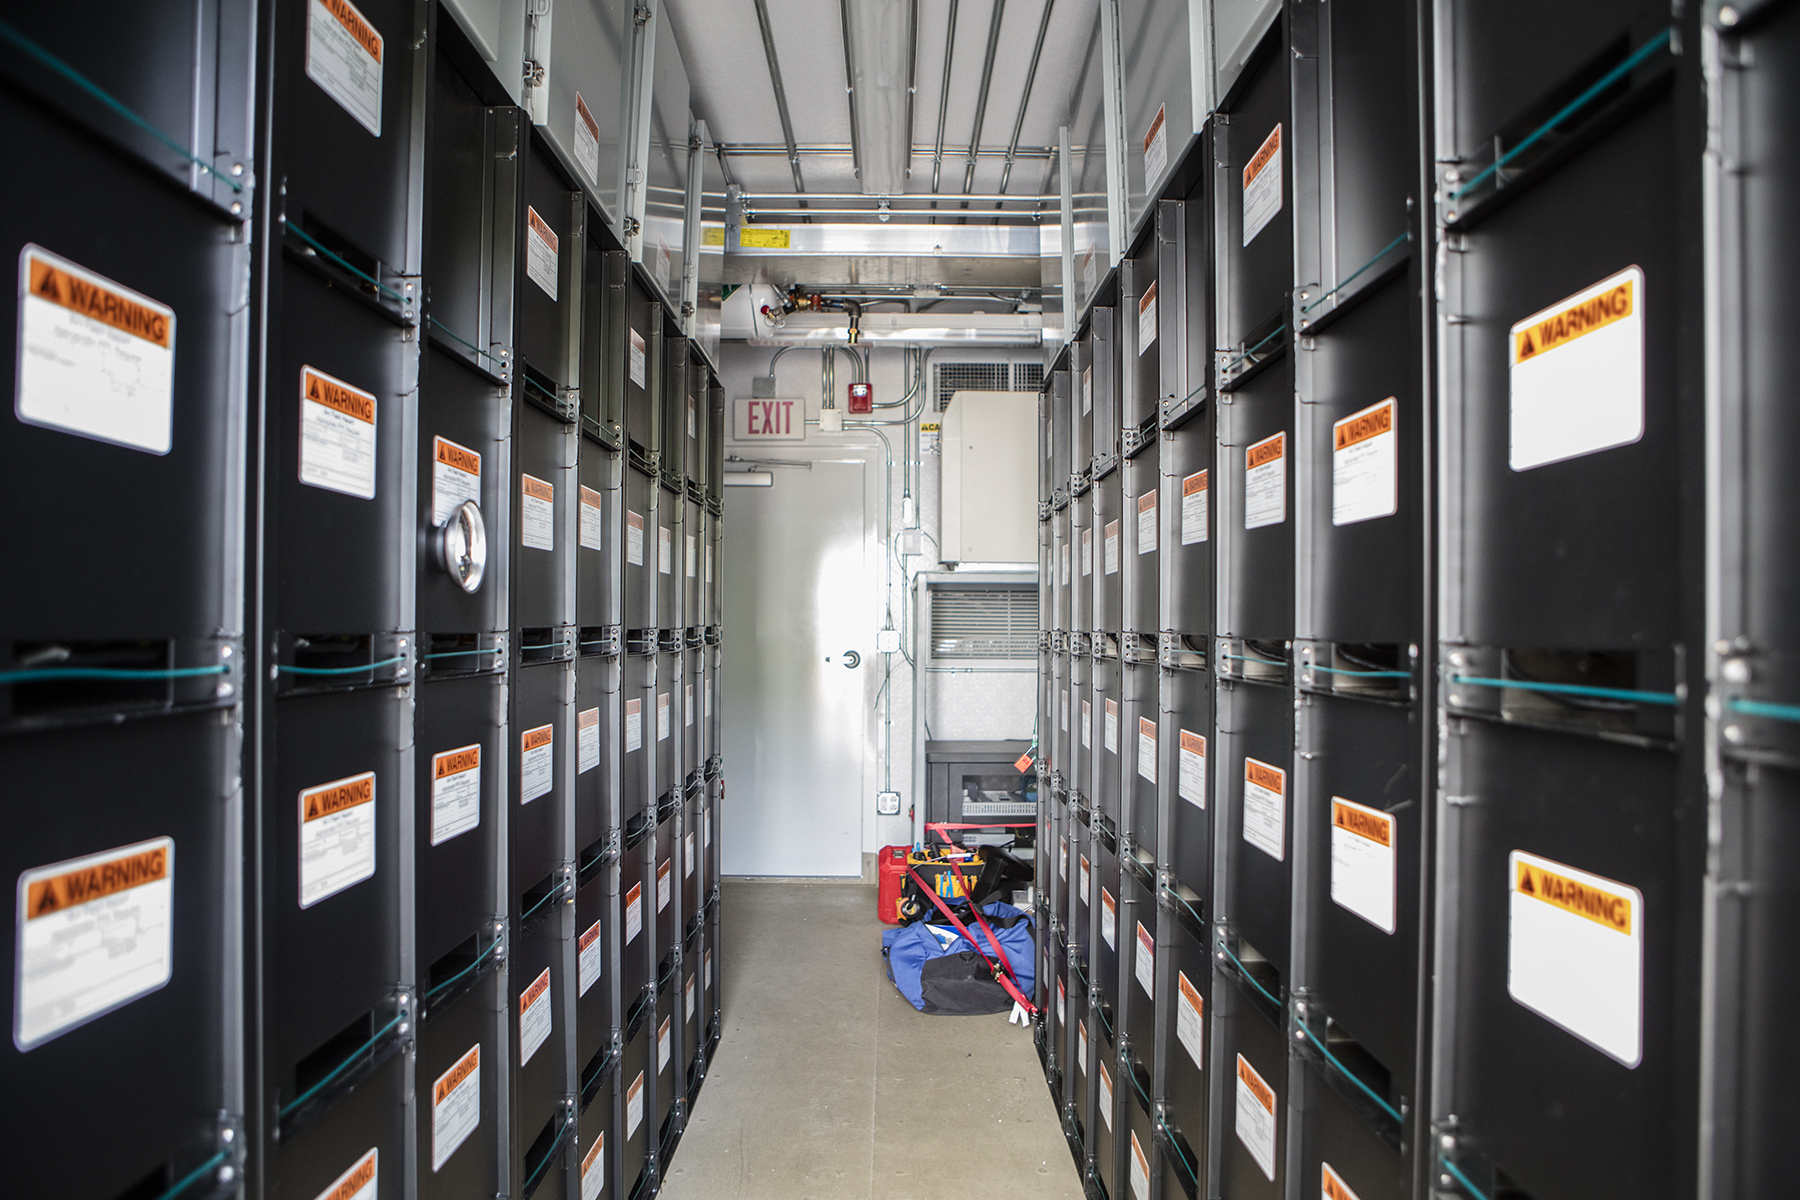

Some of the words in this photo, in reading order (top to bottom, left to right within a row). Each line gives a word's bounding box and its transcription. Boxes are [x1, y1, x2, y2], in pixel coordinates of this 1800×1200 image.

[1252, 133, 1278, 176] WARNING
[68, 276, 164, 341] WARNING
[1539, 285, 1628, 347] WARNING
[323, 382, 372, 419] WARNING
[748, 401, 794, 434] EXIT
[1347, 408, 1388, 441] WARNING
[447, 447, 478, 472] WARNING
[1255, 439, 1281, 463] WARNING
[530, 480, 551, 500] WARNING
[530, 728, 551, 747] WARNING
[447, 750, 478, 772] WARNING
[1254, 766, 1280, 791] WARNING
[322, 780, 371, 812] WARNING
[1346, 808, 1387, 841] WARNING
[66, 850, 163, 900] WARNING
[1540, 873, 1625, 928] WARNING
[446, 1051, 477, 1091] WARNING
